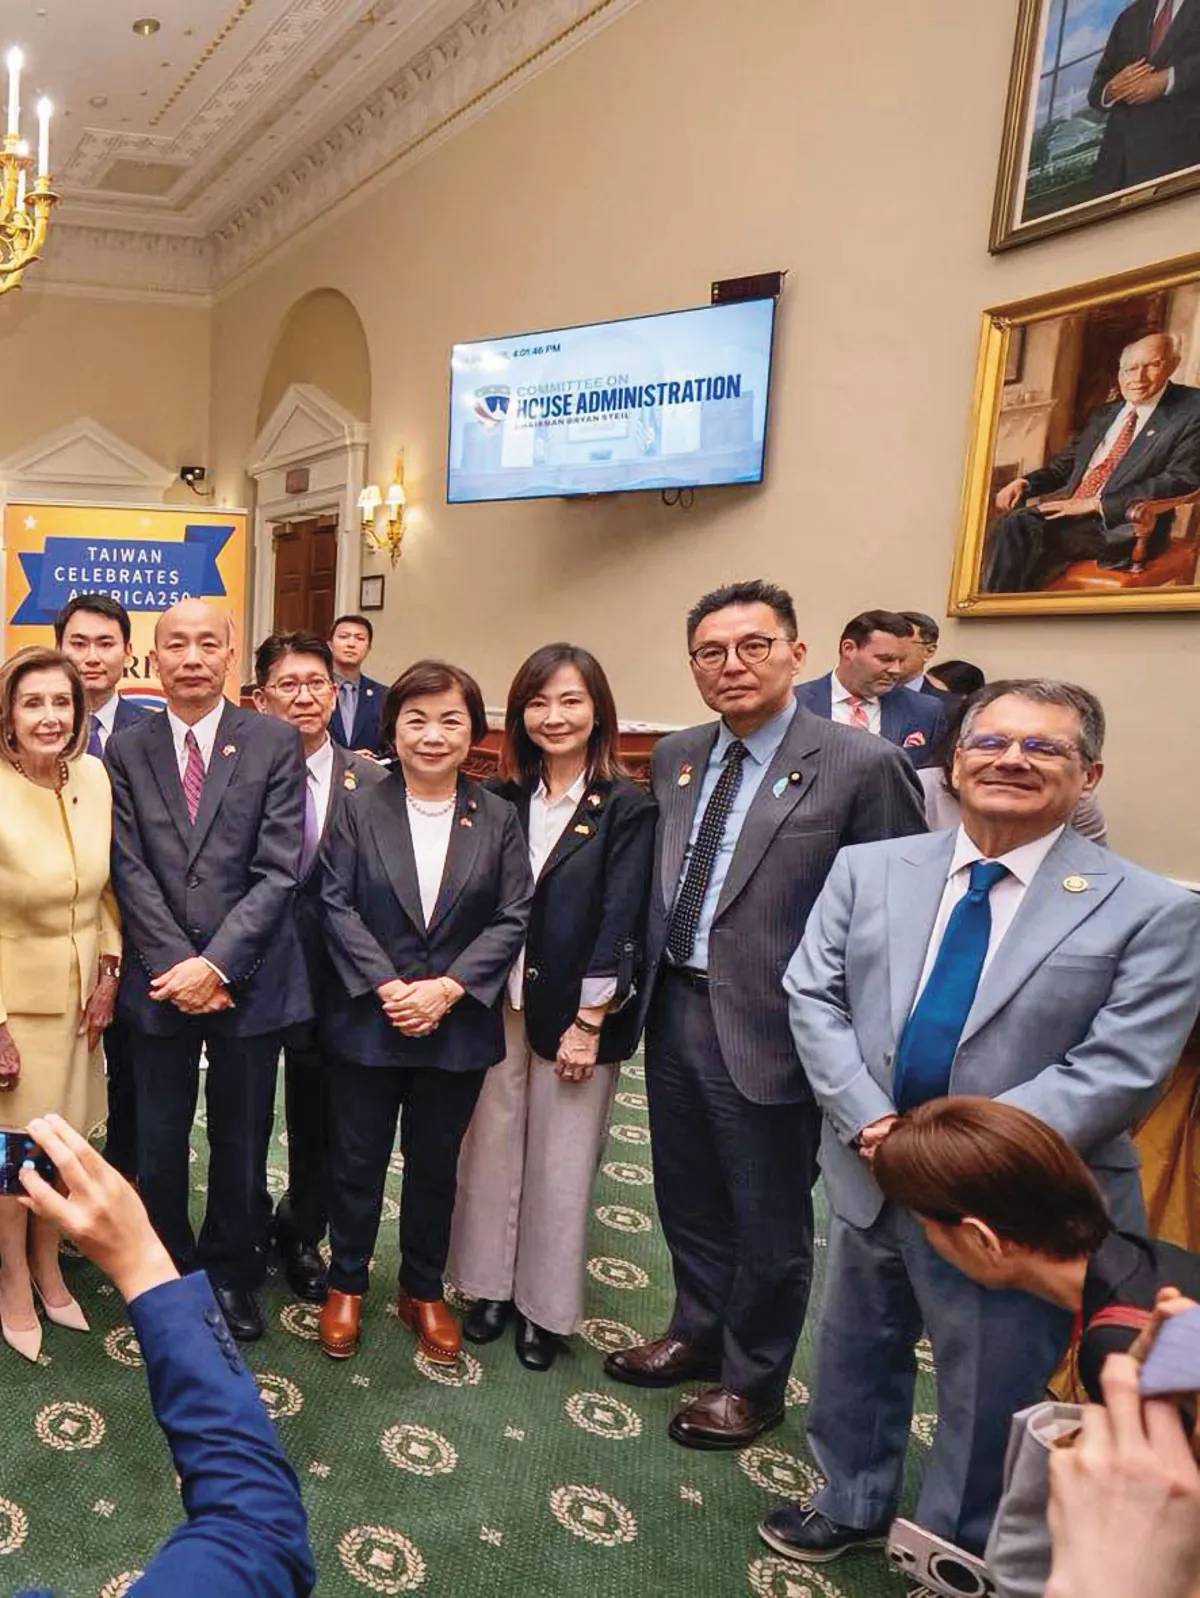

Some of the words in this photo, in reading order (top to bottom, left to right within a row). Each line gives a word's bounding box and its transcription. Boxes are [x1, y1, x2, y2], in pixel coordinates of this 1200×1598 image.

[545, 343, 561, 353] PM
[516, 377, 602, 397] COMMITTEE
[607, 374, 629, 386] ON
[517, 394, 572, 419] HOUSE
[576, 374, 741, 414] ADMINISTRATION
[566, 414, 599, 425] BRYAN
[602, 412, 630, 421] STEIL
[88, 546, 162, 563] TAIWAN
[54, 566, 180, 585] CELEBRATES
